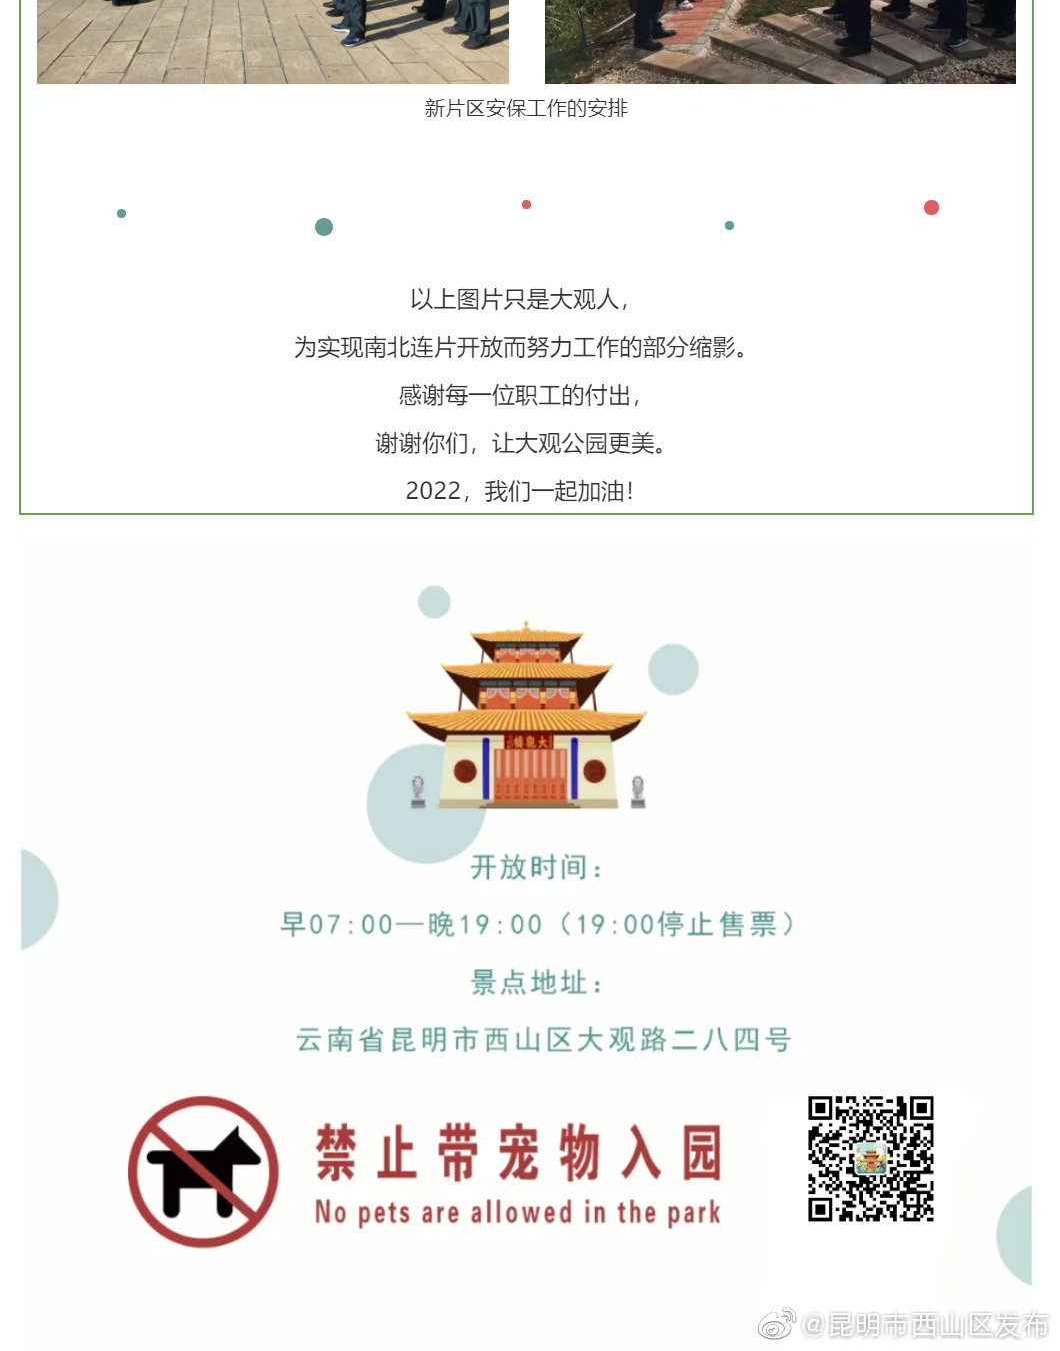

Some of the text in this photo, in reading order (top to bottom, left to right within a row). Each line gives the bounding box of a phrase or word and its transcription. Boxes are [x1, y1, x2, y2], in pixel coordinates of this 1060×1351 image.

[410, 287, 627, 311] 以上图片只是大观人，
[294, 335, 744, 359] 为实现南北连片开放而努力工作的部分缩影。
[399, 383, 639, 407] 感谢每一位职工的付出，
[375, 431, 663, 455] 谢谢你们，让大观公园更美。
[470, 853, 601, 881] 开放时间：
[470, 968, 601, 996] 景点地址：
[296, 1025, 792, 1053] 云南省昆明市西山区大观路二八四号
[315, 1121, 721, 1183] 禁止带宠物入园
[315, 1198, 721, 1230] No pets are allowed in the park
